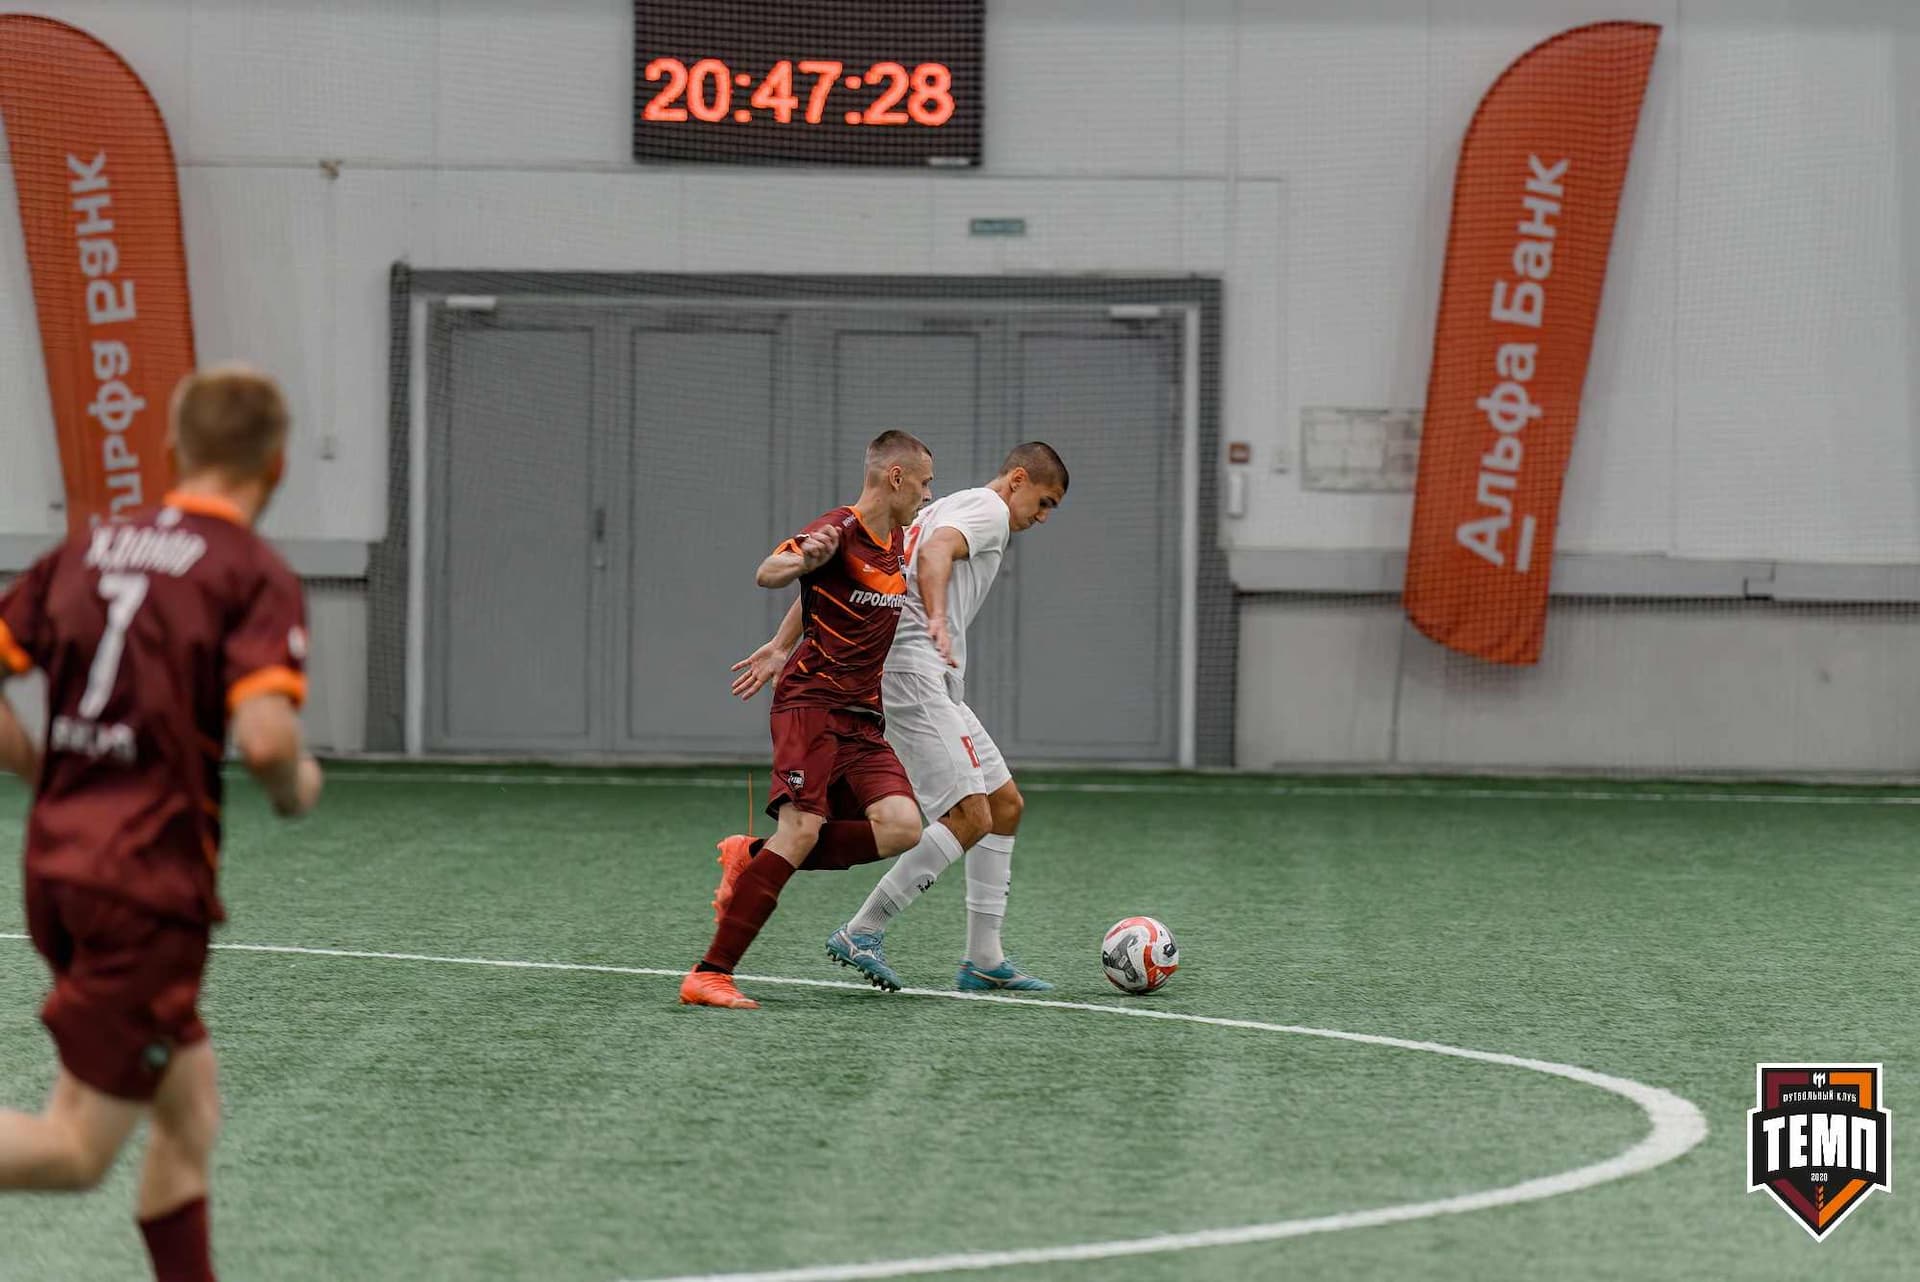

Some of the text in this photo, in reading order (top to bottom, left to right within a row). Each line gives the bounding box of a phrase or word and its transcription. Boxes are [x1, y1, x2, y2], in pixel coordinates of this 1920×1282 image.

[641, 57, 956, 127] 20:47:28
[1456, 153, 1568, 567] Альфа Банк
[79, 572, 149, 719] 7
